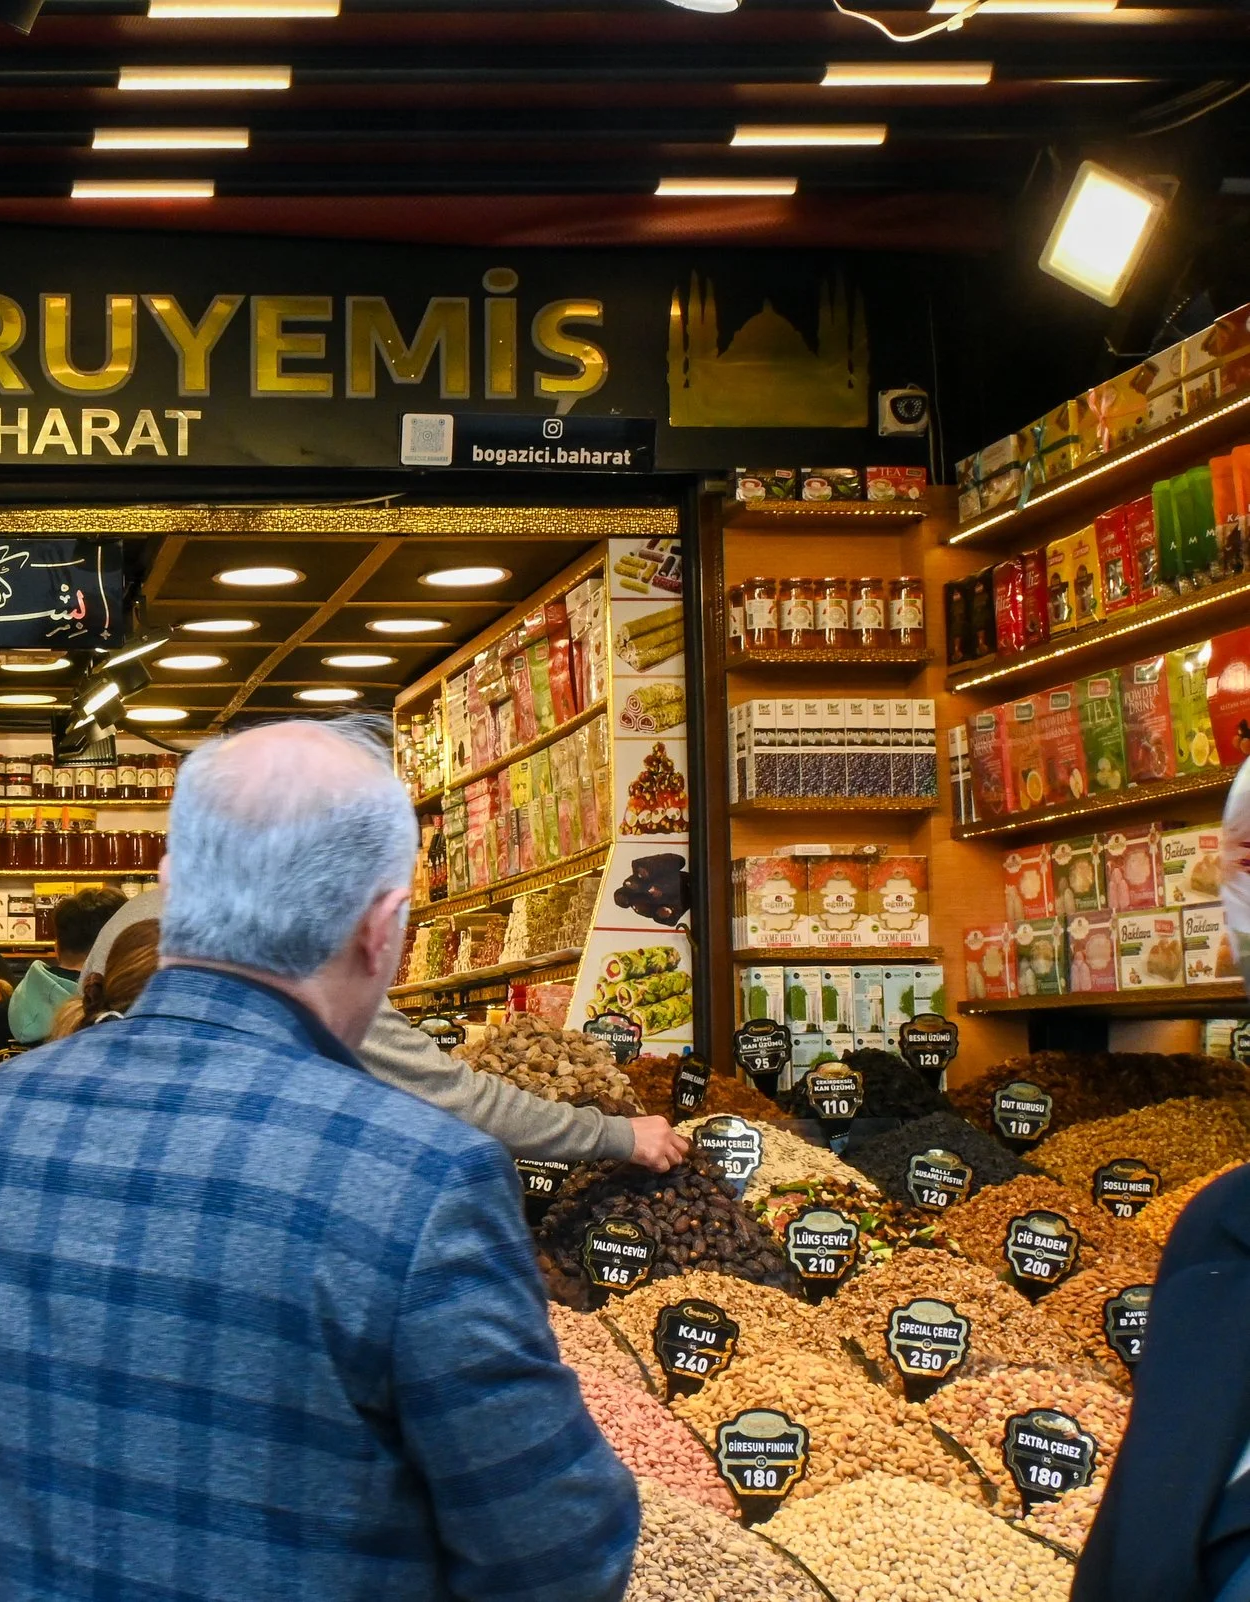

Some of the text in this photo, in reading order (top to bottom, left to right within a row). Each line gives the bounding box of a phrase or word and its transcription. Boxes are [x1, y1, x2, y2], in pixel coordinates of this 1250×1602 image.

[471, 444, 632, 468] bogazici.baharat
[1085, 697, 1115, 726] TEA
[1163, 843, 1198, 861] Baklava
[1120, 925, 1151, 943] Baklava
[1184, 918, 1220, 936] Baklava
[612, 1032, 633, 1043] ÜZÜM
[742, 1039, 784, 1051] KAN ÜZÜMÜ
[908, 1031, 951, 1043] BESNİ ÜZÜMÜ
[754, 1058, 770, 1071] 95
[919, 1054, 940, 1066] 120
[830, 1080, 856, 1092] ÜZÜMÜ
[681, 1092, 695, 1107] 140
[822, 1099, 849, 1115] 110
[1001, 1099, 1045, 1113] DUT KURUSU
[1009, 1120, 1031, 1135] 110
[702, 1136, 753, 1153] YAŞAM ÇEREZİ
[528, 1174, 554, 1196] 190
[914, 1168, 964, 1187] SUSAMLI FISTIK
[1102, 1181, 1151, 1195] SOSLU MISIR
[921, 1189, 948, 1207] 120
[1115, 1203, 1132, 1218] 70
[796, 1231, 849, 1247] LÜKS CEVİZ
[1016, 1230, 1068, 1253] ÇİĞ BADEM
[592, 1238, 648, 1260] YALOVA CEVİZİ
[808, 1256, 836, 1274] 210
[1023, 1257, 1051, 1278] 200
[601, 1265, 630, 1285] 165
[677, 1324, 717, 1345] KAJU
[899, 1321, 959, 1342] SPECIAL ÇEREZ
[674, 1352, 709, 1374] 240
[909, 1351, 942, 1371] 250
[728, 1439, 795, 1454] GİRESUN FINDIK
[1017, 1432, 1081, 1460] EXTRA ÇEREZ
[743, 1468, 778, 1488] 180
[1028, 1464, 1063, 1489] 180
